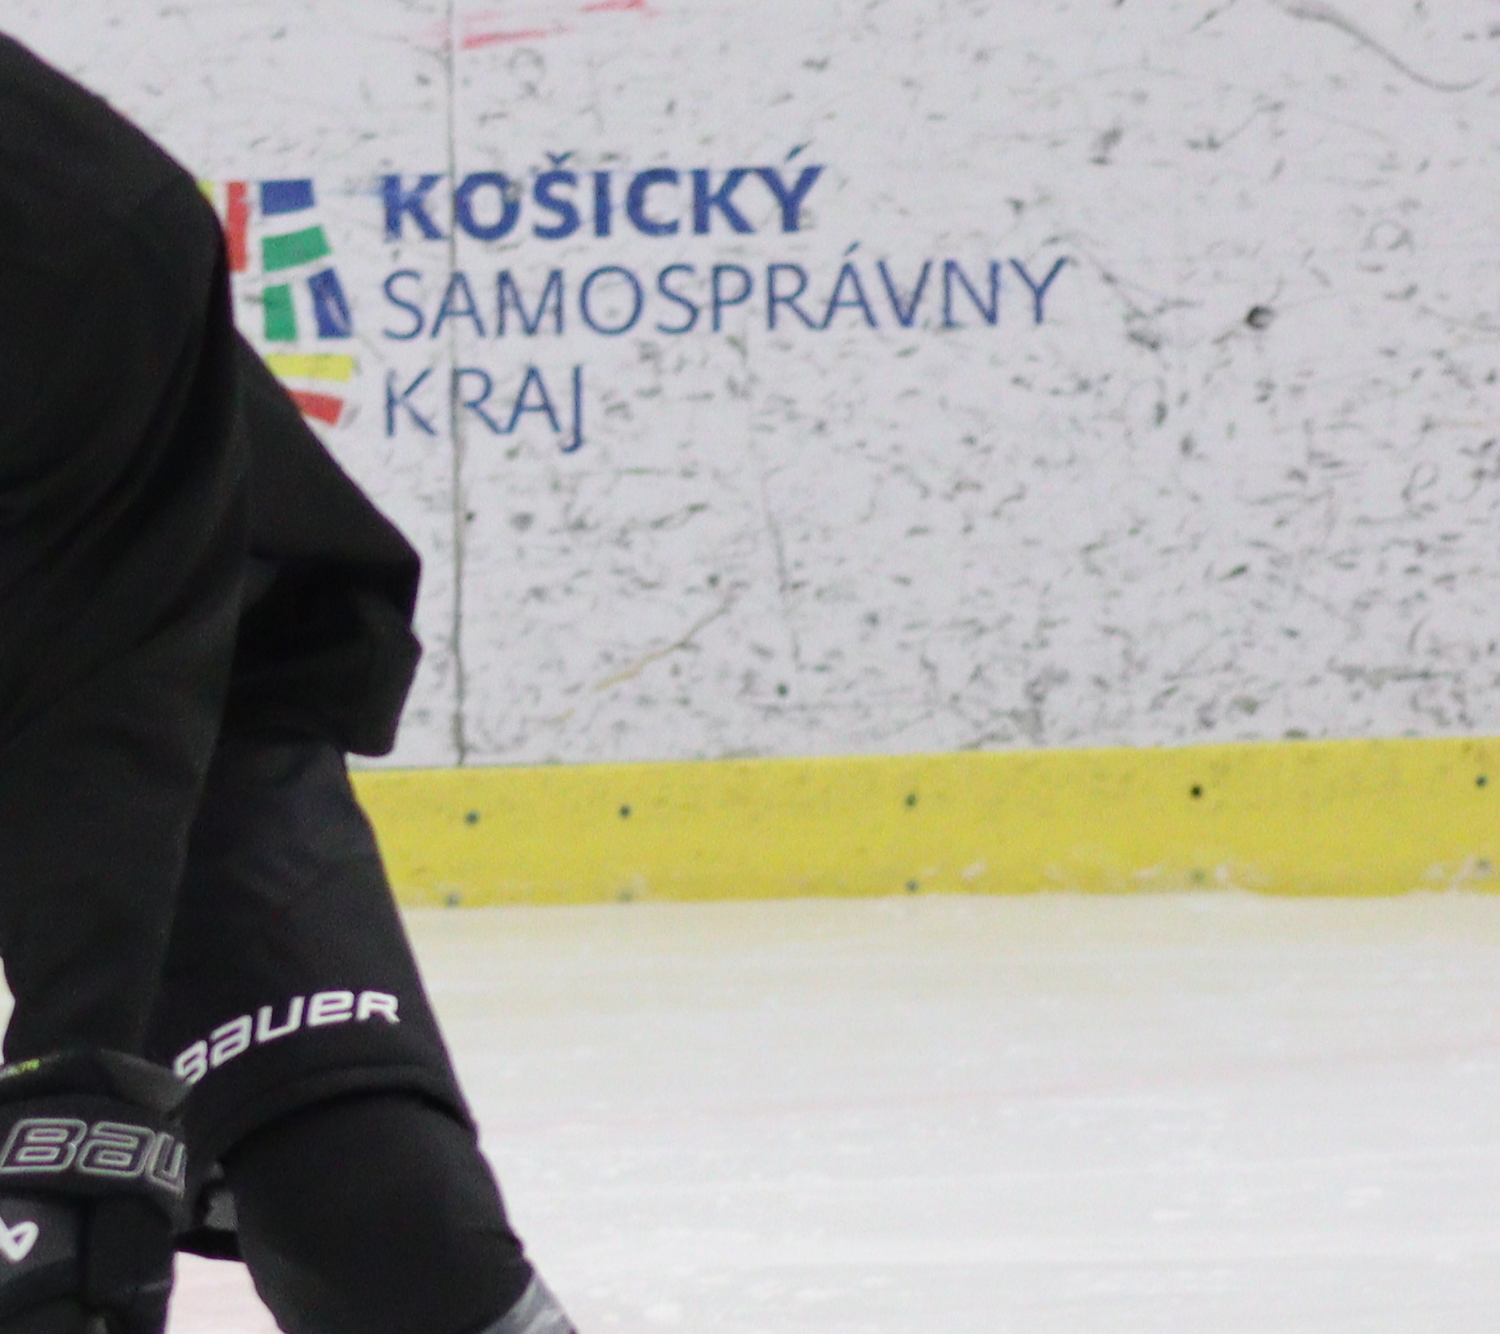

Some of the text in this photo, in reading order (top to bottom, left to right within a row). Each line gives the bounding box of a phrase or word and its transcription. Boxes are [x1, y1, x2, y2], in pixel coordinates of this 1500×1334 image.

[381, 143, 823, 242] KOŠICKÝ
[383, 242, 1070, 341] SAMOSPRÁVNY
[384, 364, 584, 454] KRAJ
